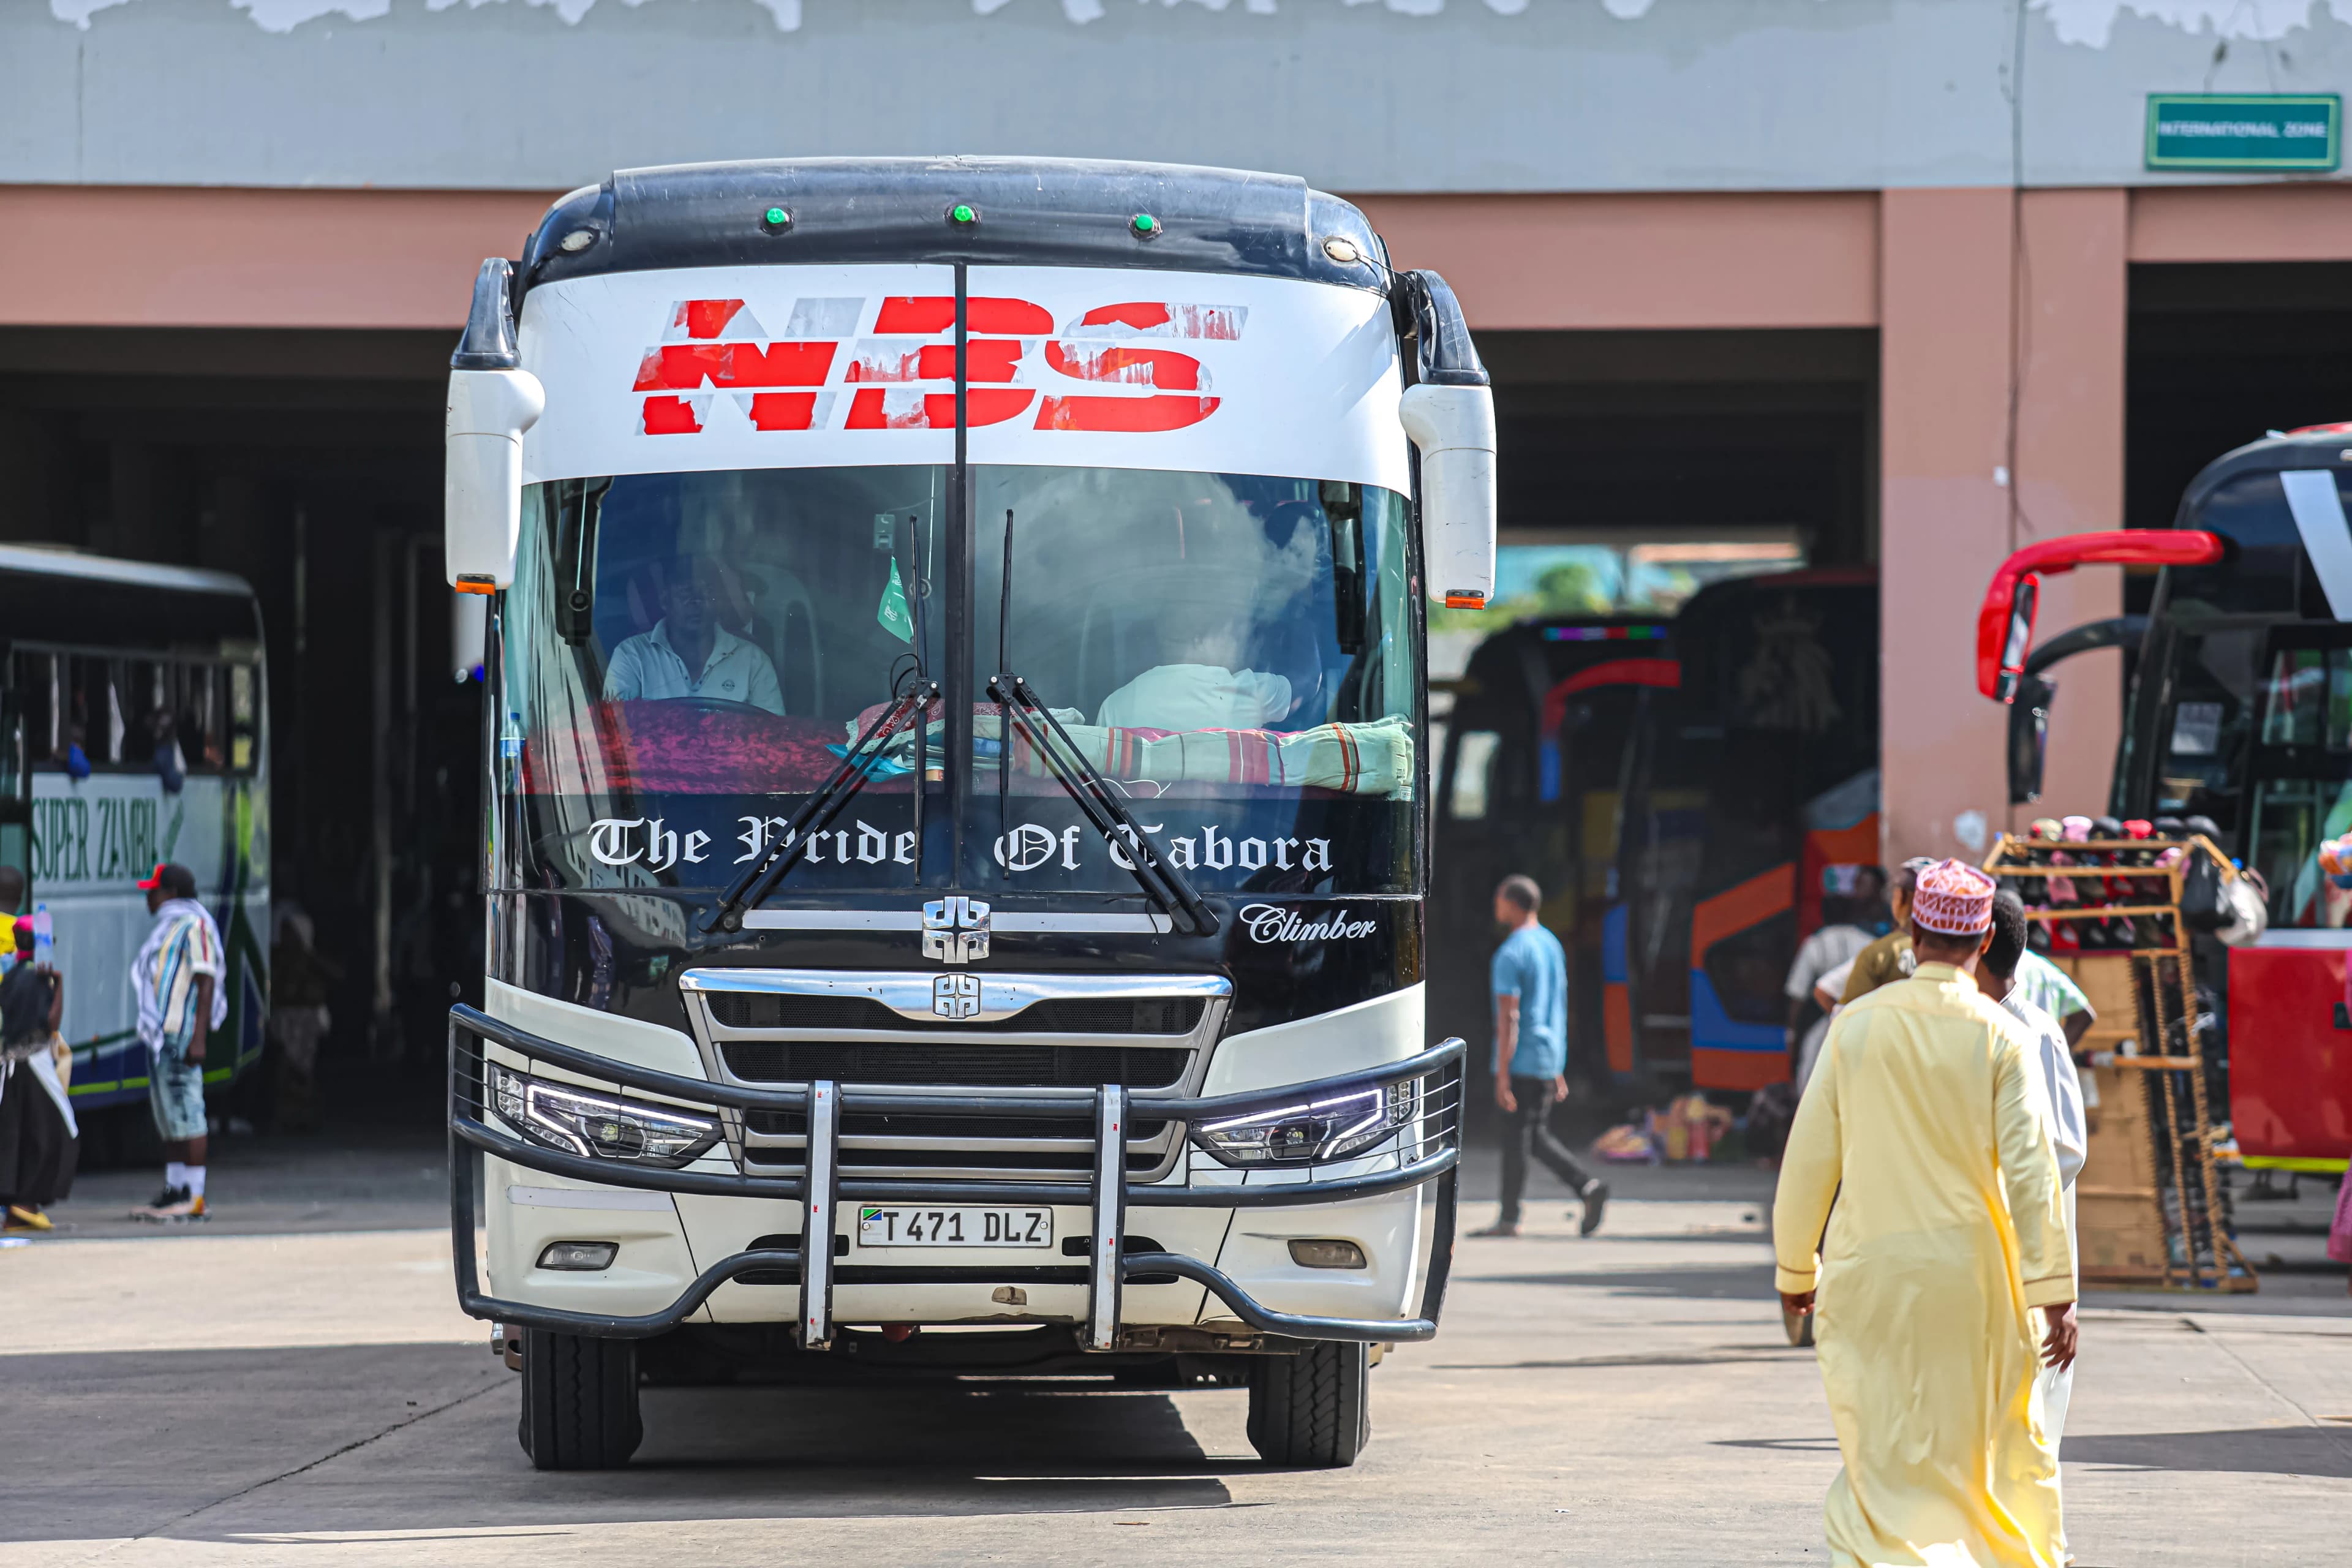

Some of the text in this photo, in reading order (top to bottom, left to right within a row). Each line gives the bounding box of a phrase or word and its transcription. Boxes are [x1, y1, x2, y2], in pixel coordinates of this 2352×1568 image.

[632, 296, 1249, 435] NBS
[32, 797, 89, 881] SUPER
[587, 816, 712, 873] The
[993, 823, 1081, 872] Of
[1238, 903, 1377, 944] Climber
[883, 1212, 1042, 1243] T 471 DLZ
